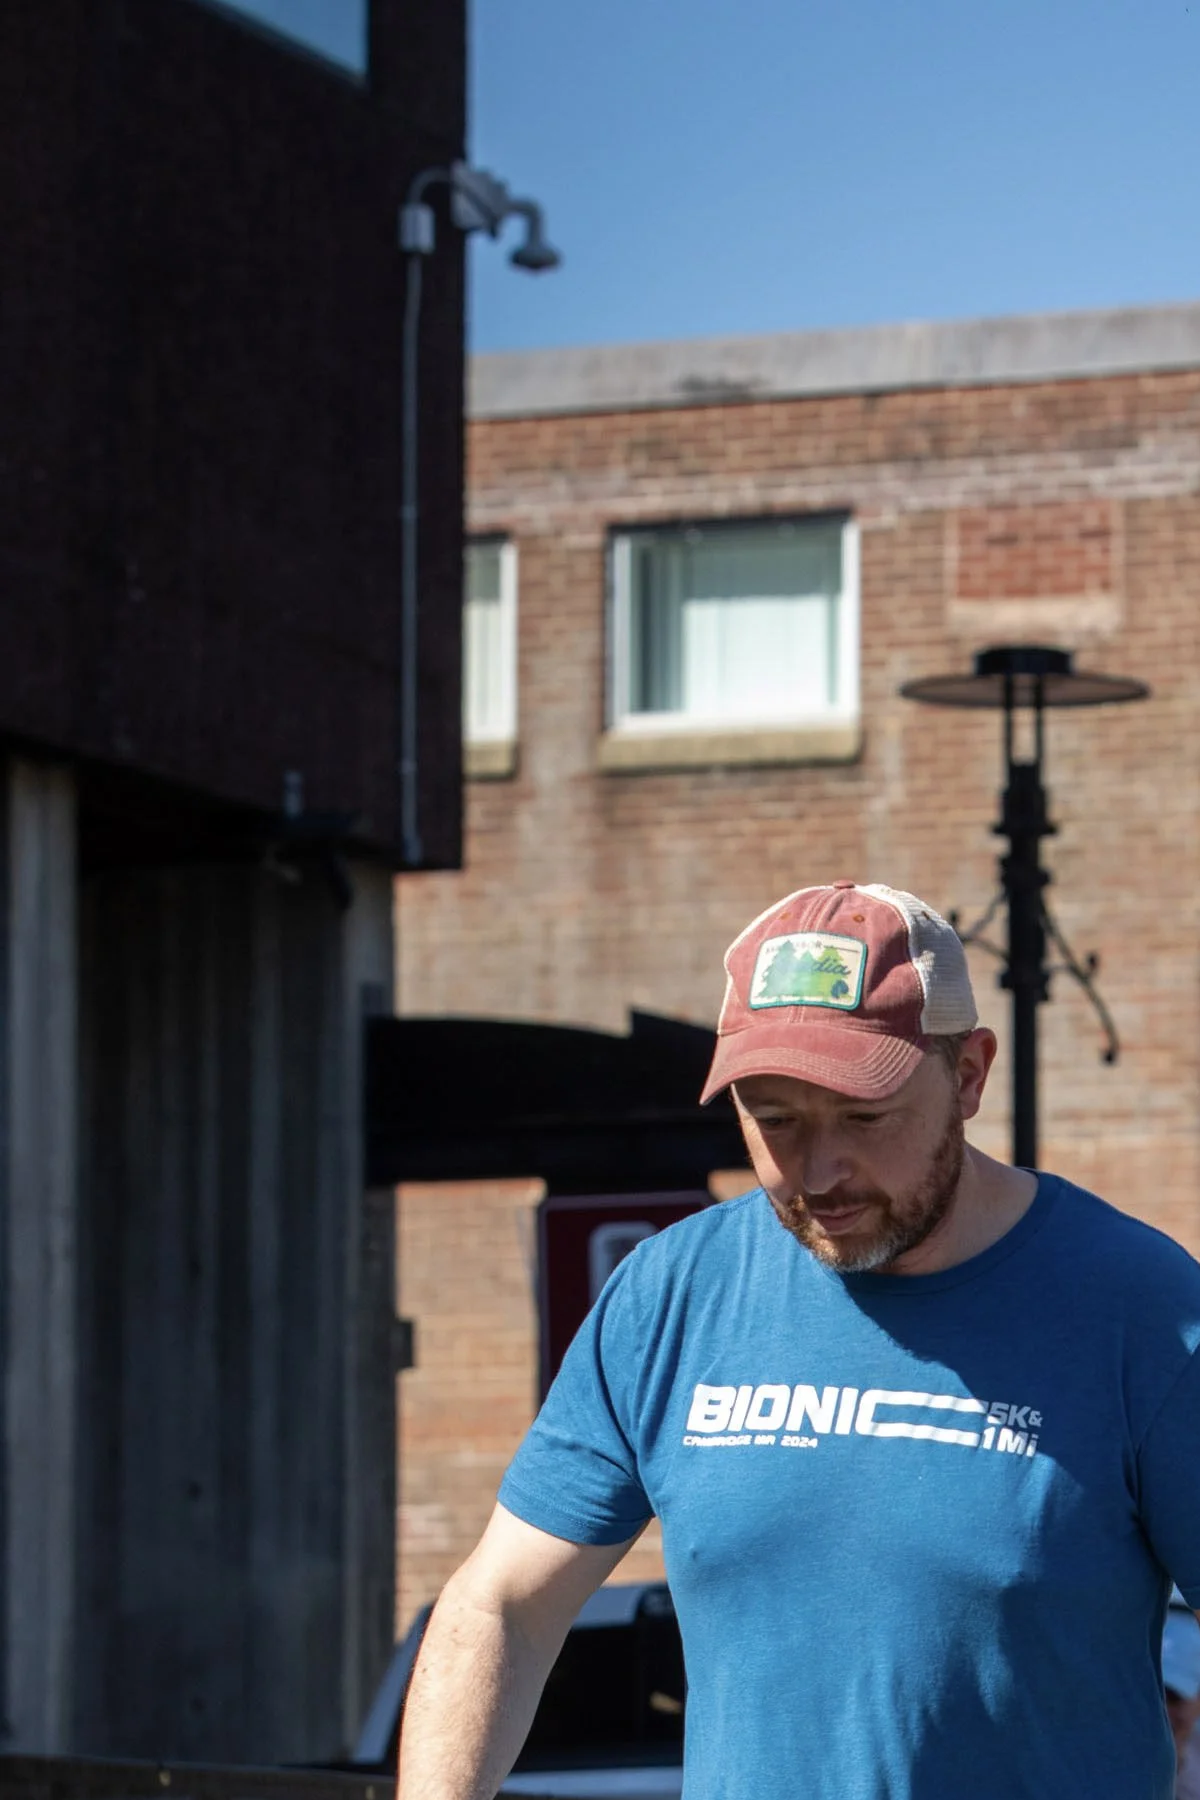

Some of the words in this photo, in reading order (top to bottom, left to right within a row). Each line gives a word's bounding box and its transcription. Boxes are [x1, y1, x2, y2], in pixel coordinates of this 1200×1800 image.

[686, 1384, 989, 1447] BIONIC
[987, 1401, 1044, 1429] 5K&
[780, 1435, 819, 1449] 2024
